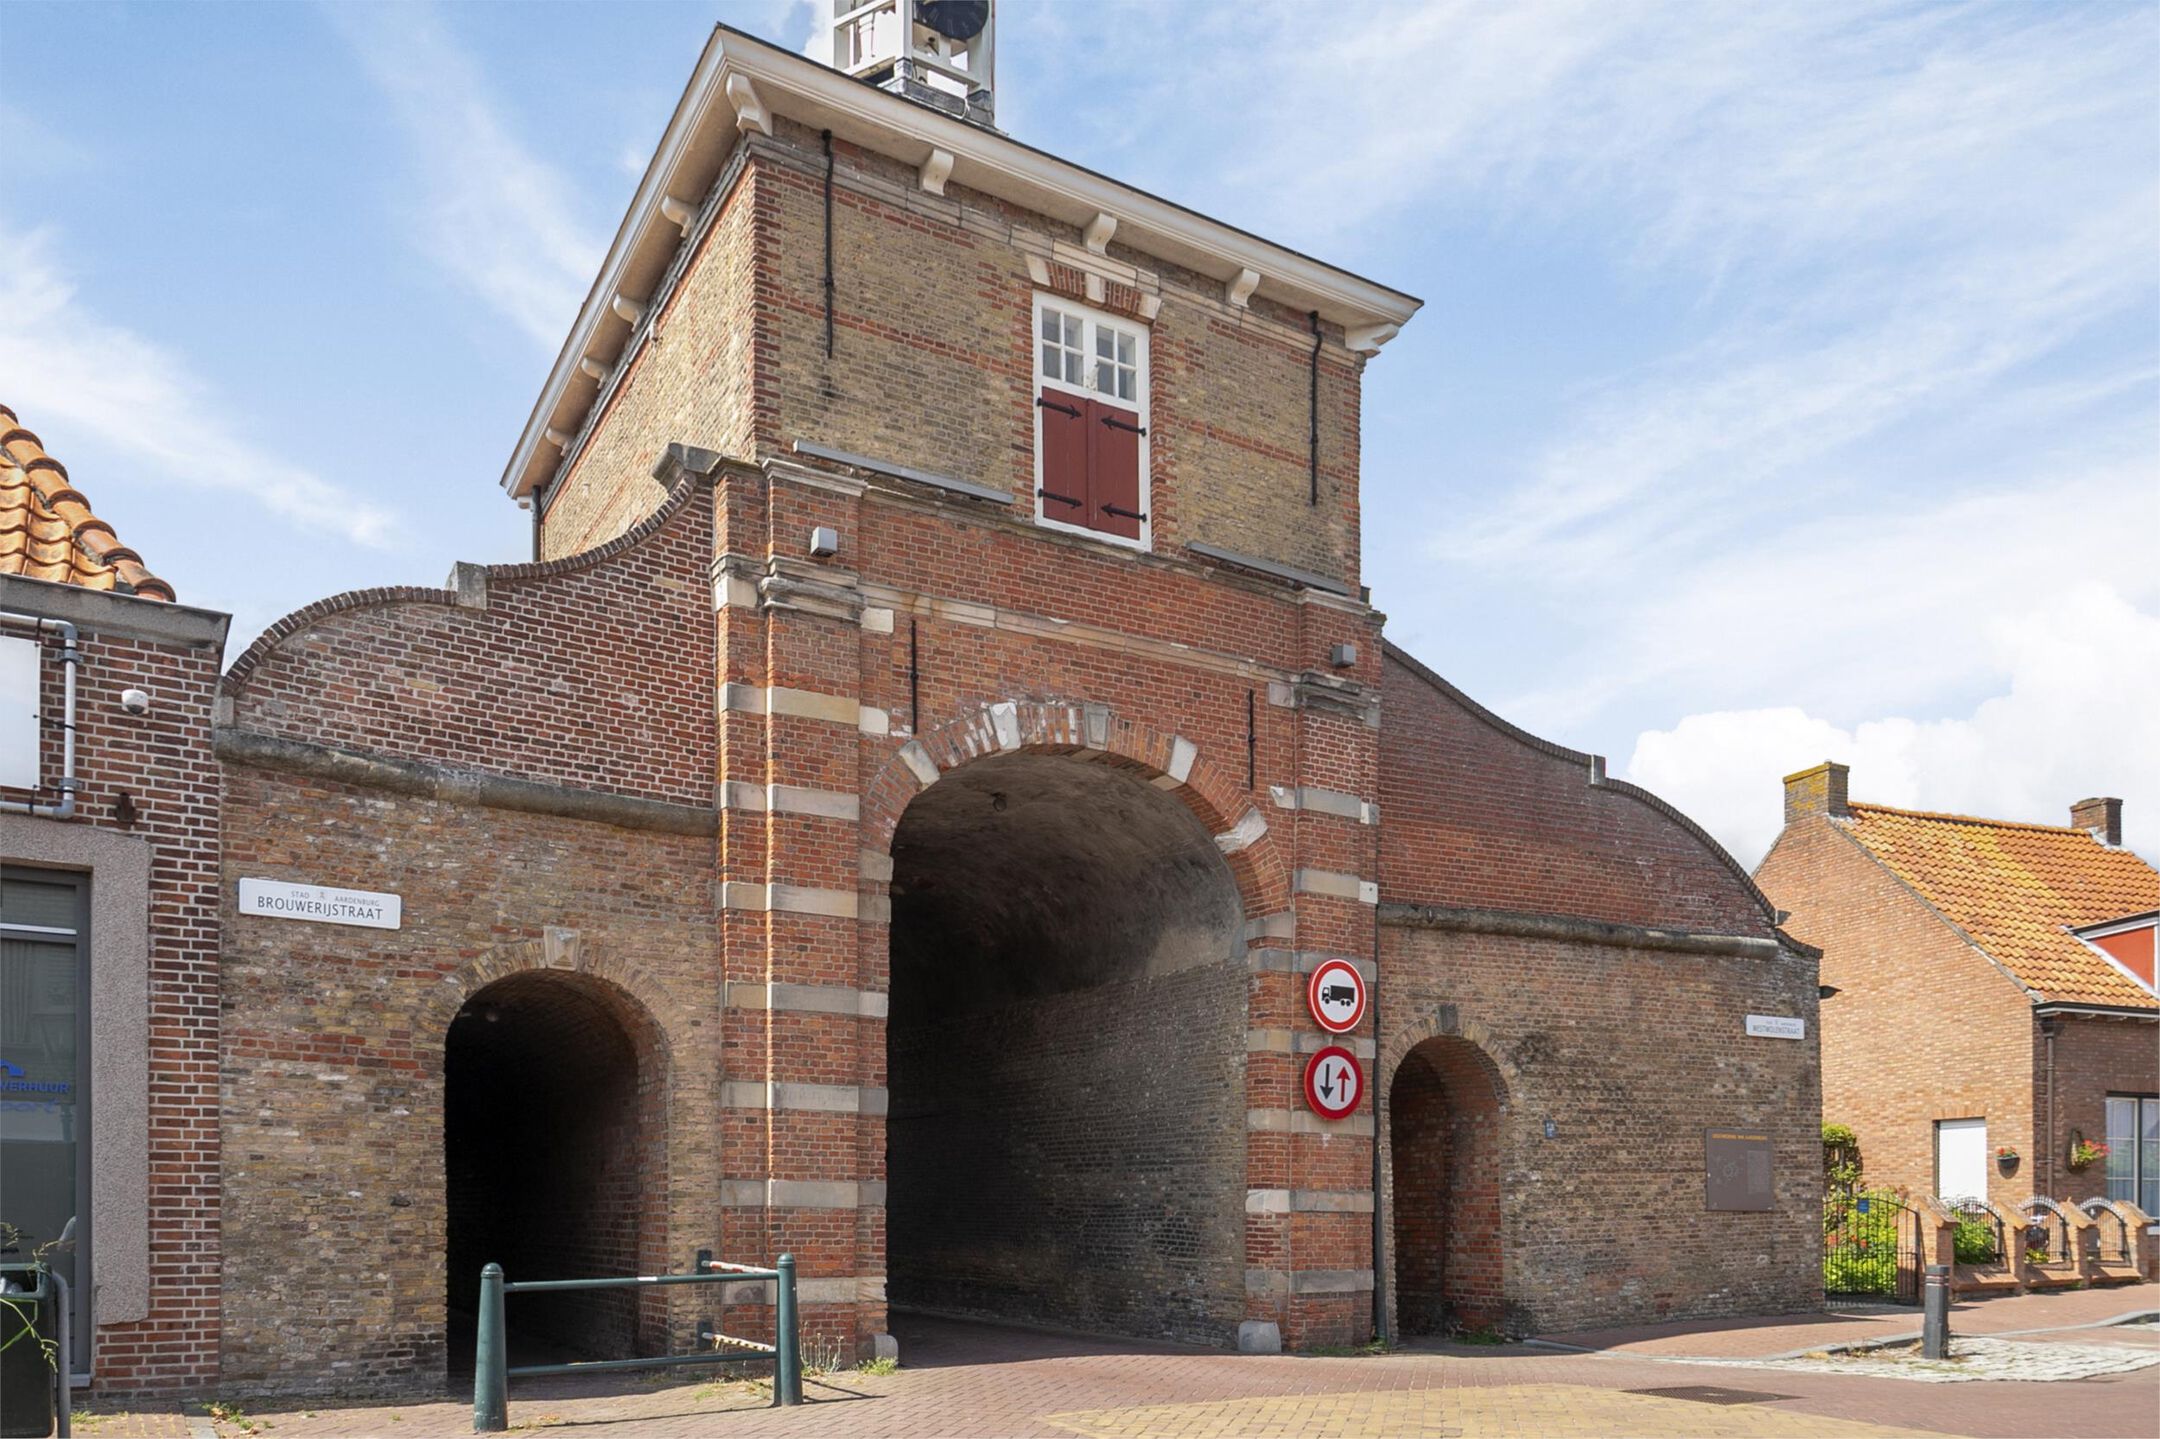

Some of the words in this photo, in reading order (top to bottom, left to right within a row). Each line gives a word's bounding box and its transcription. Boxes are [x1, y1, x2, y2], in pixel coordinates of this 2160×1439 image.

[257, 895, 384, 921] BROUWERIJSTRAAT
[291, 890, 310, 900] STAD
[334, 895, 380, 908] AARDENBURG
